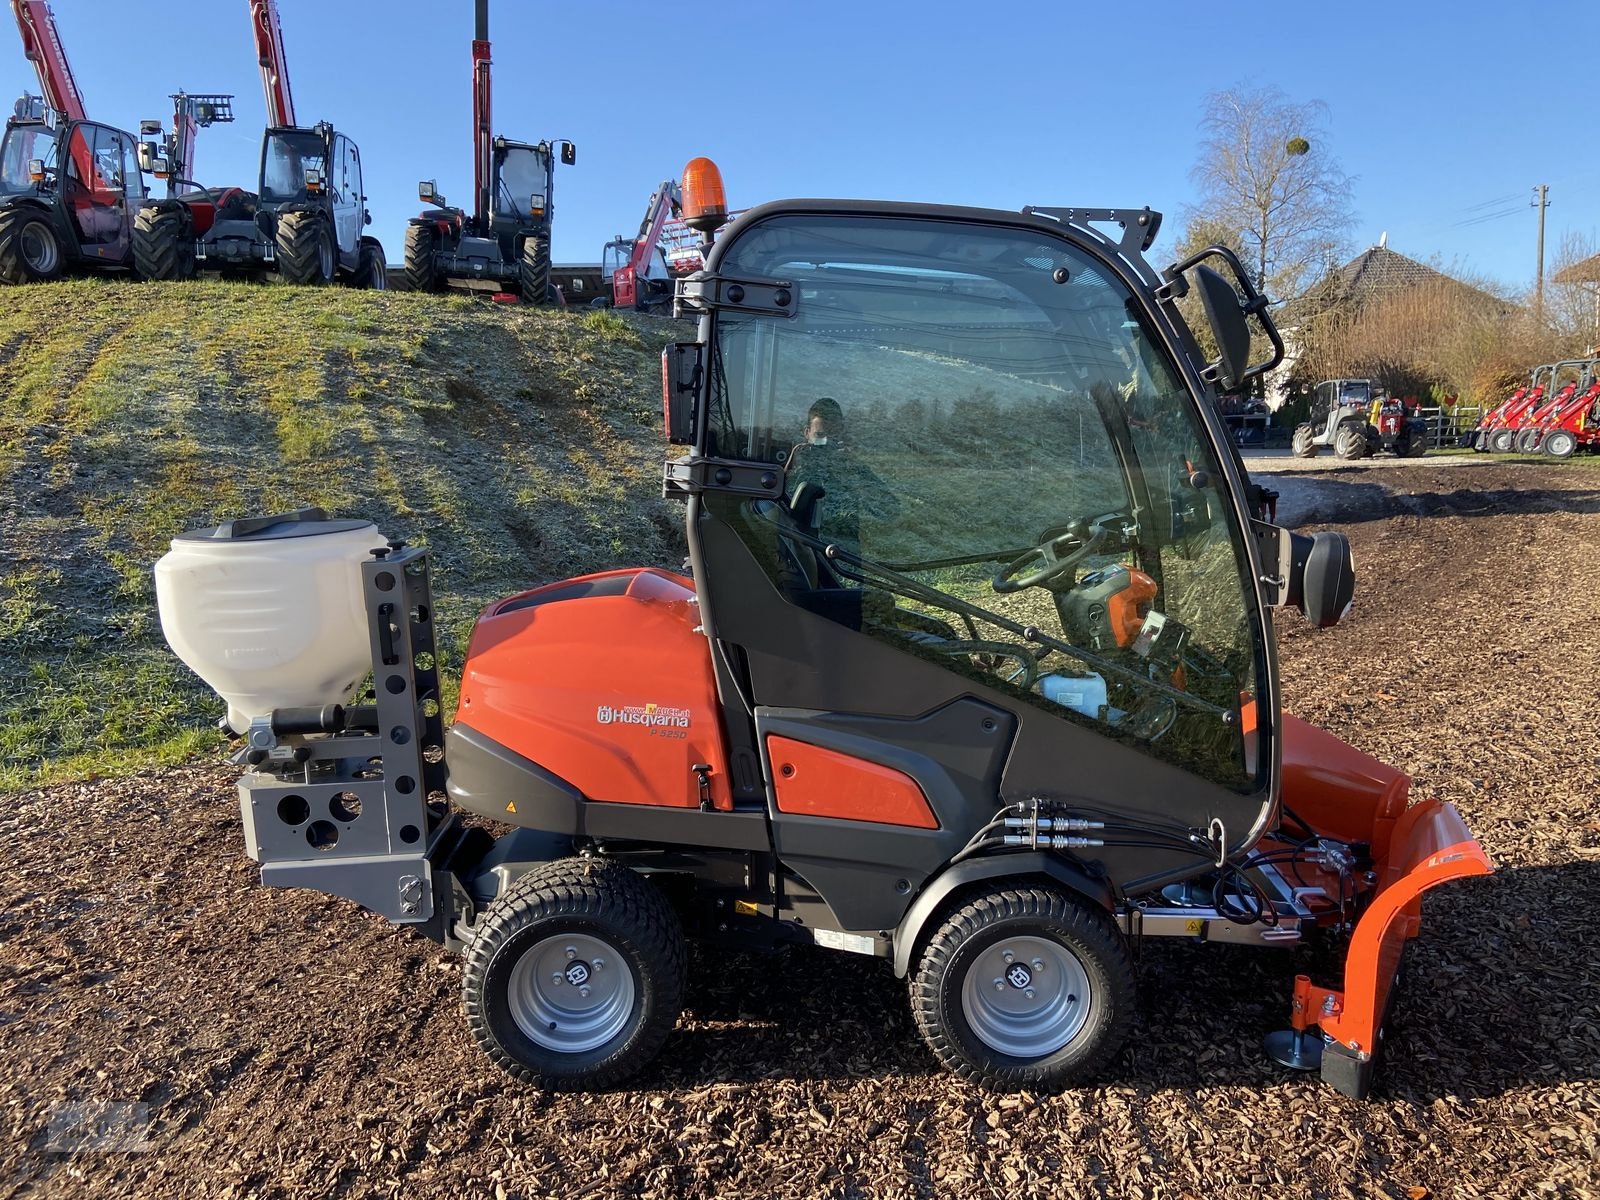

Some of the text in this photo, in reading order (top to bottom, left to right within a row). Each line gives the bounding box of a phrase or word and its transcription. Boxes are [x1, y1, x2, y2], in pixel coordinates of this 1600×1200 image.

[44, 15, 77, 98] WEIDEMANN
[613, 709, 689, 727] Husqvarna
[650, 729, 657, 737] P
